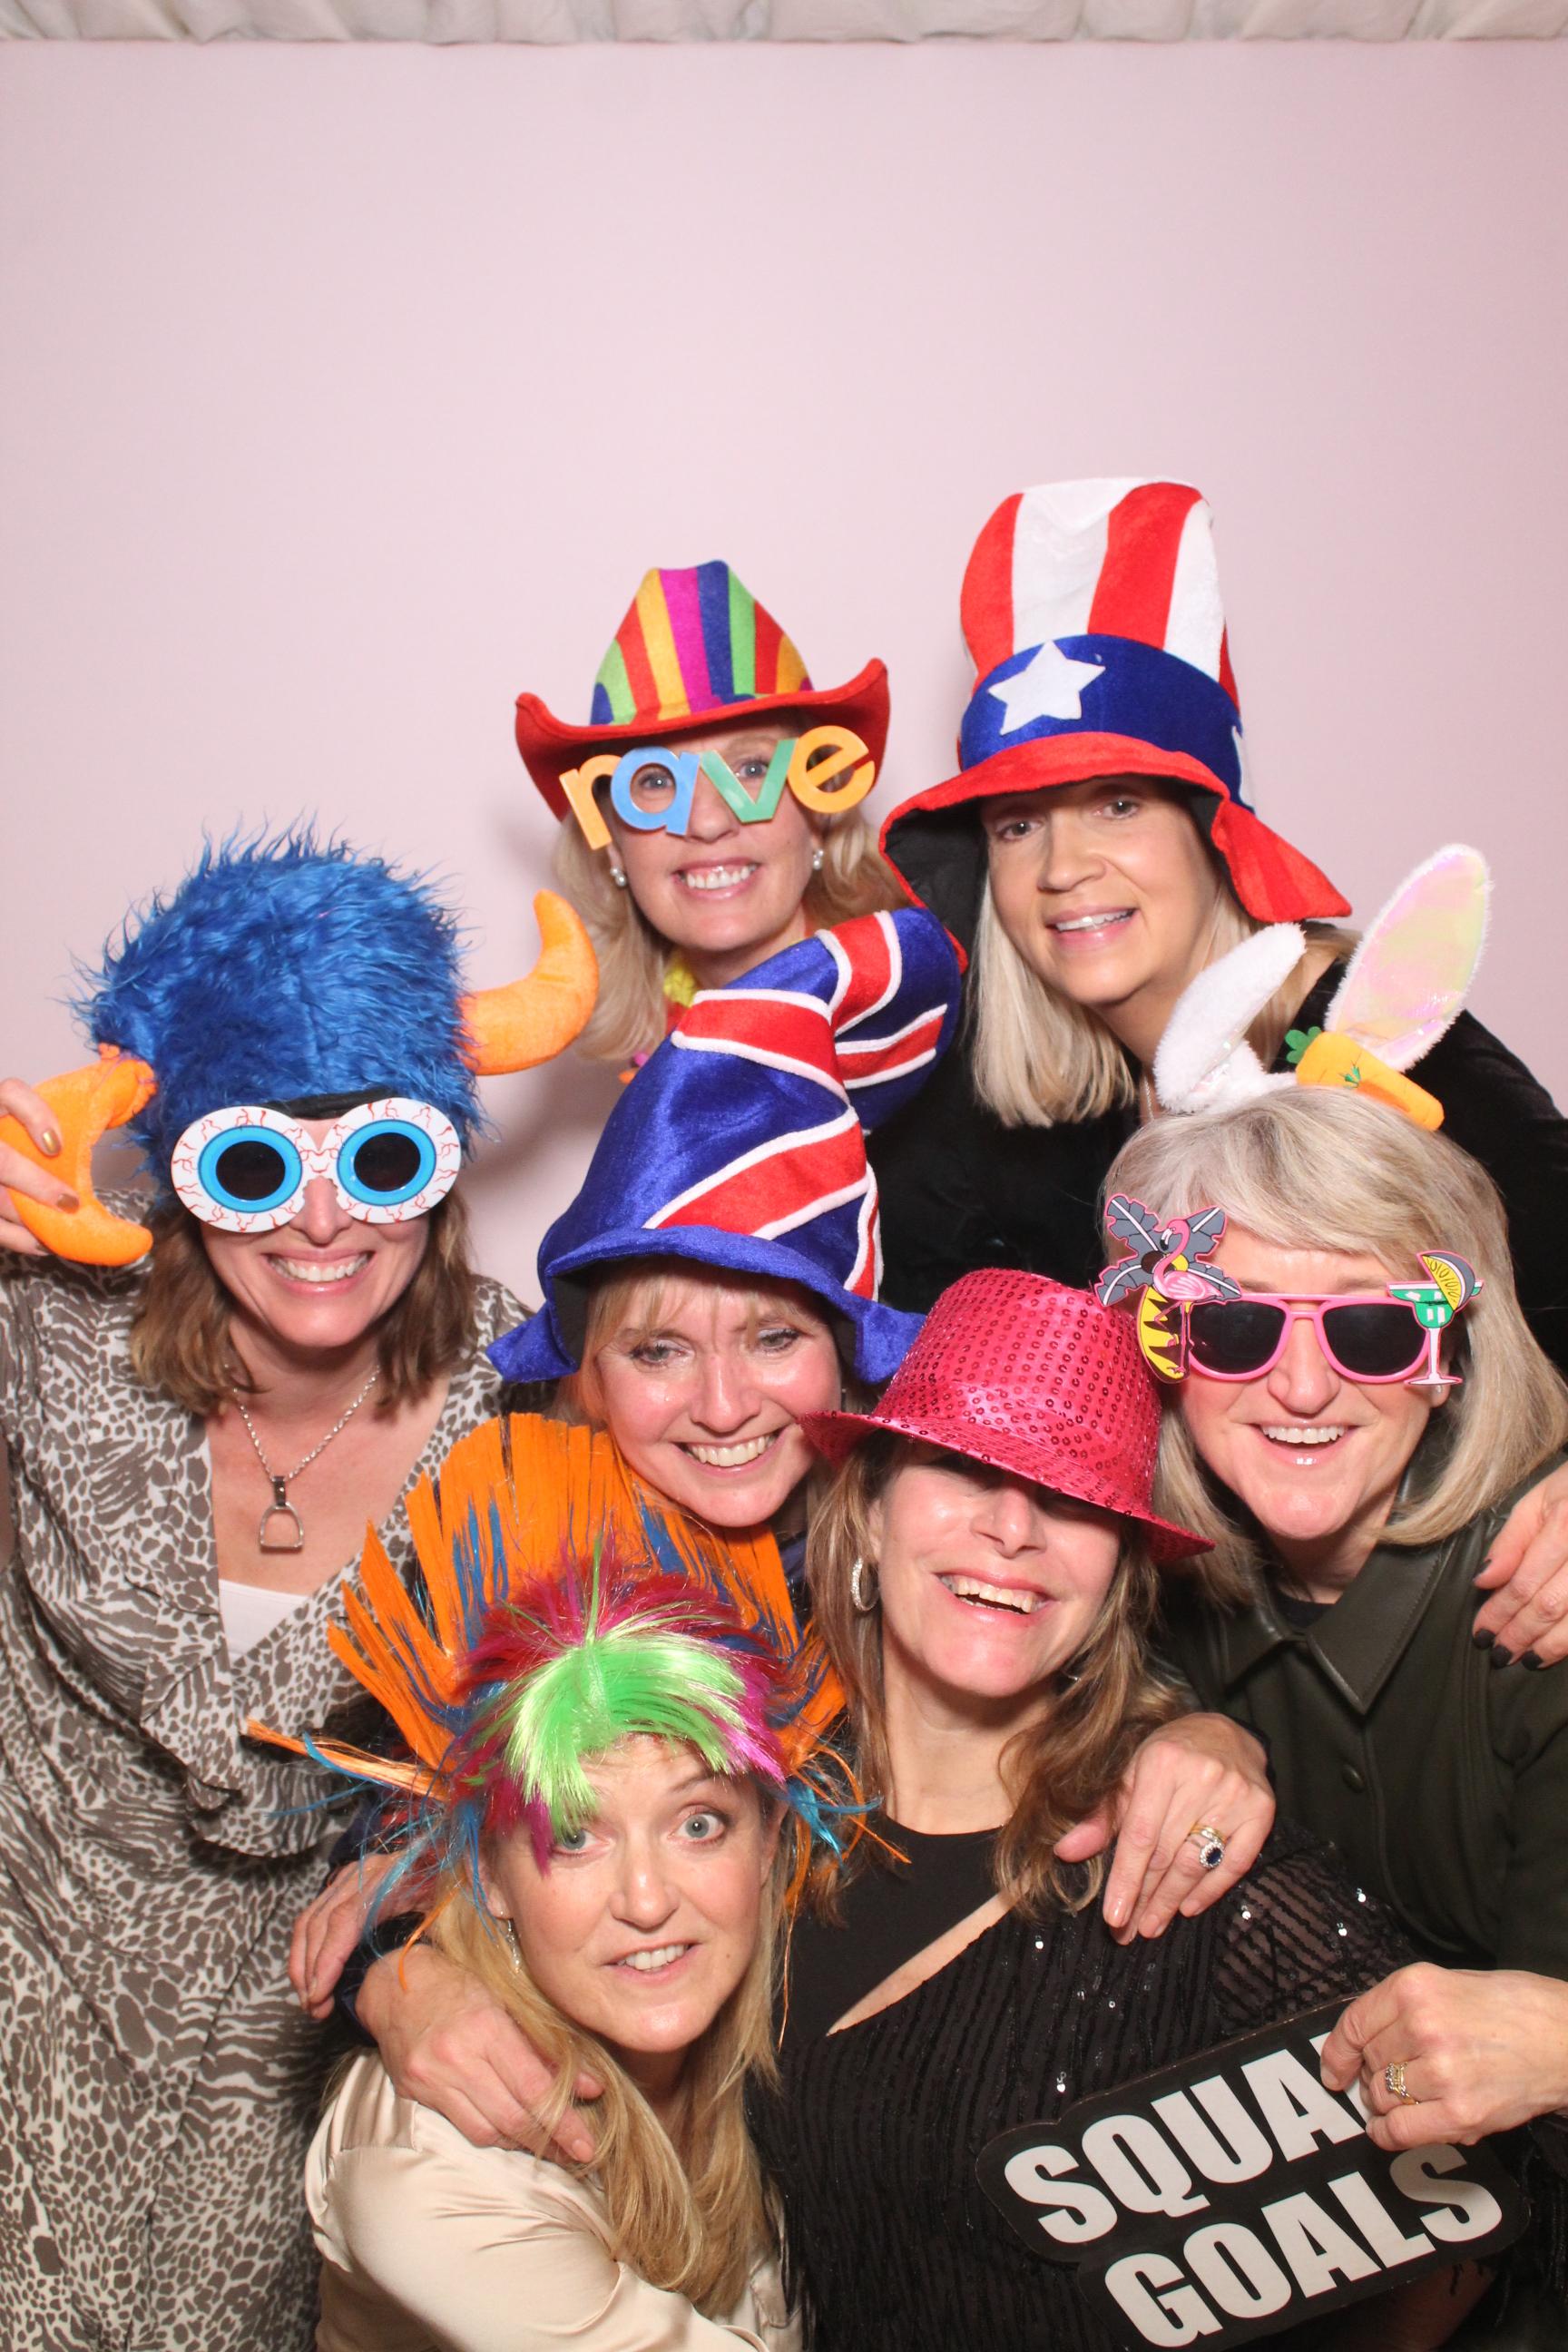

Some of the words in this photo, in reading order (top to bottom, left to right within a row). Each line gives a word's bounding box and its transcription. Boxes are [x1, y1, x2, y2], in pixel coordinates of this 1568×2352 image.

[559, 725, 876, 850] rave
[1004, 2032, 1370, 2243] SQUA
[1104, 2143, 1503, 2347] GOALS
